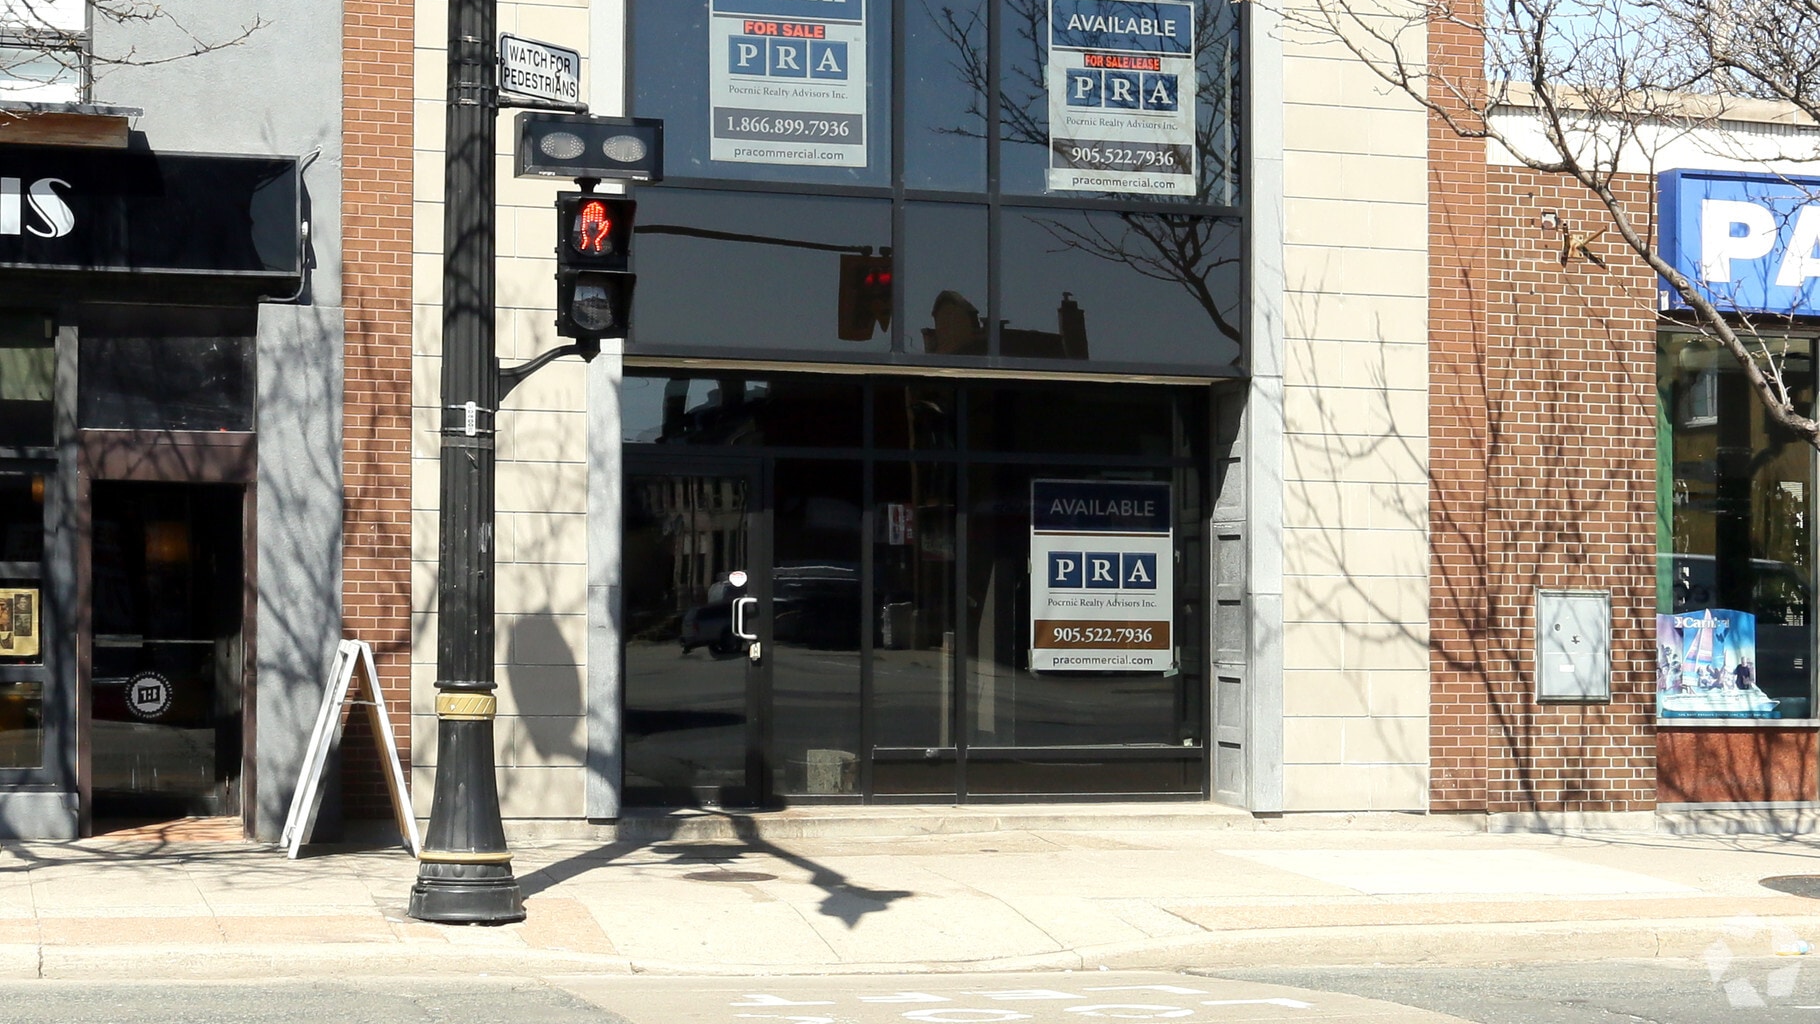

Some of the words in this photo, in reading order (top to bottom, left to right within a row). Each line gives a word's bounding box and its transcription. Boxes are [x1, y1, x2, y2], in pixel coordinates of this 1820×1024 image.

[743, 21, 778, 36] FOR
[781, 24, 825, 39] SALE
[1067, 14, 1177, 37] AVAILABLE
[509, 45, 548, 69] WATCH
[550, 55, 571, 75] FOR
[1084, 56, 1104, 68] FOR
[1104, 57, 1160, 71] SALE/LEASE
[503, 67, 576, 98] PEDESTRIANS
[763, 87, 789, 99] Realty
[791, 88, 830, 99] Advisors
[832, 89, 849, 100] Inc.
[727, 116, 849, 137] 1.866.899.7936
[1099, 118, 1125, 129] Realty
[1126, 120, 1162, 130] Advisors
[1162, 121, 1179, 131] Inc.
[734, 146, 844, 162] pracommercial.com
[1071, 147, 1174, 167] 905.522.7936
[1072, 176, 1176, 190] pracommercial.com
[1050, 499, 1156, 517] AVAILABLE
[1080, 599, 1104, 609] Realty
[1106, 599, 1141, 608] Advisors
[1142, 599, 1157, 608] Inc.
[1053, 628, 1153, 644] 905.522.7936
[1052, 656, 1153, 667] pracommercial.com
